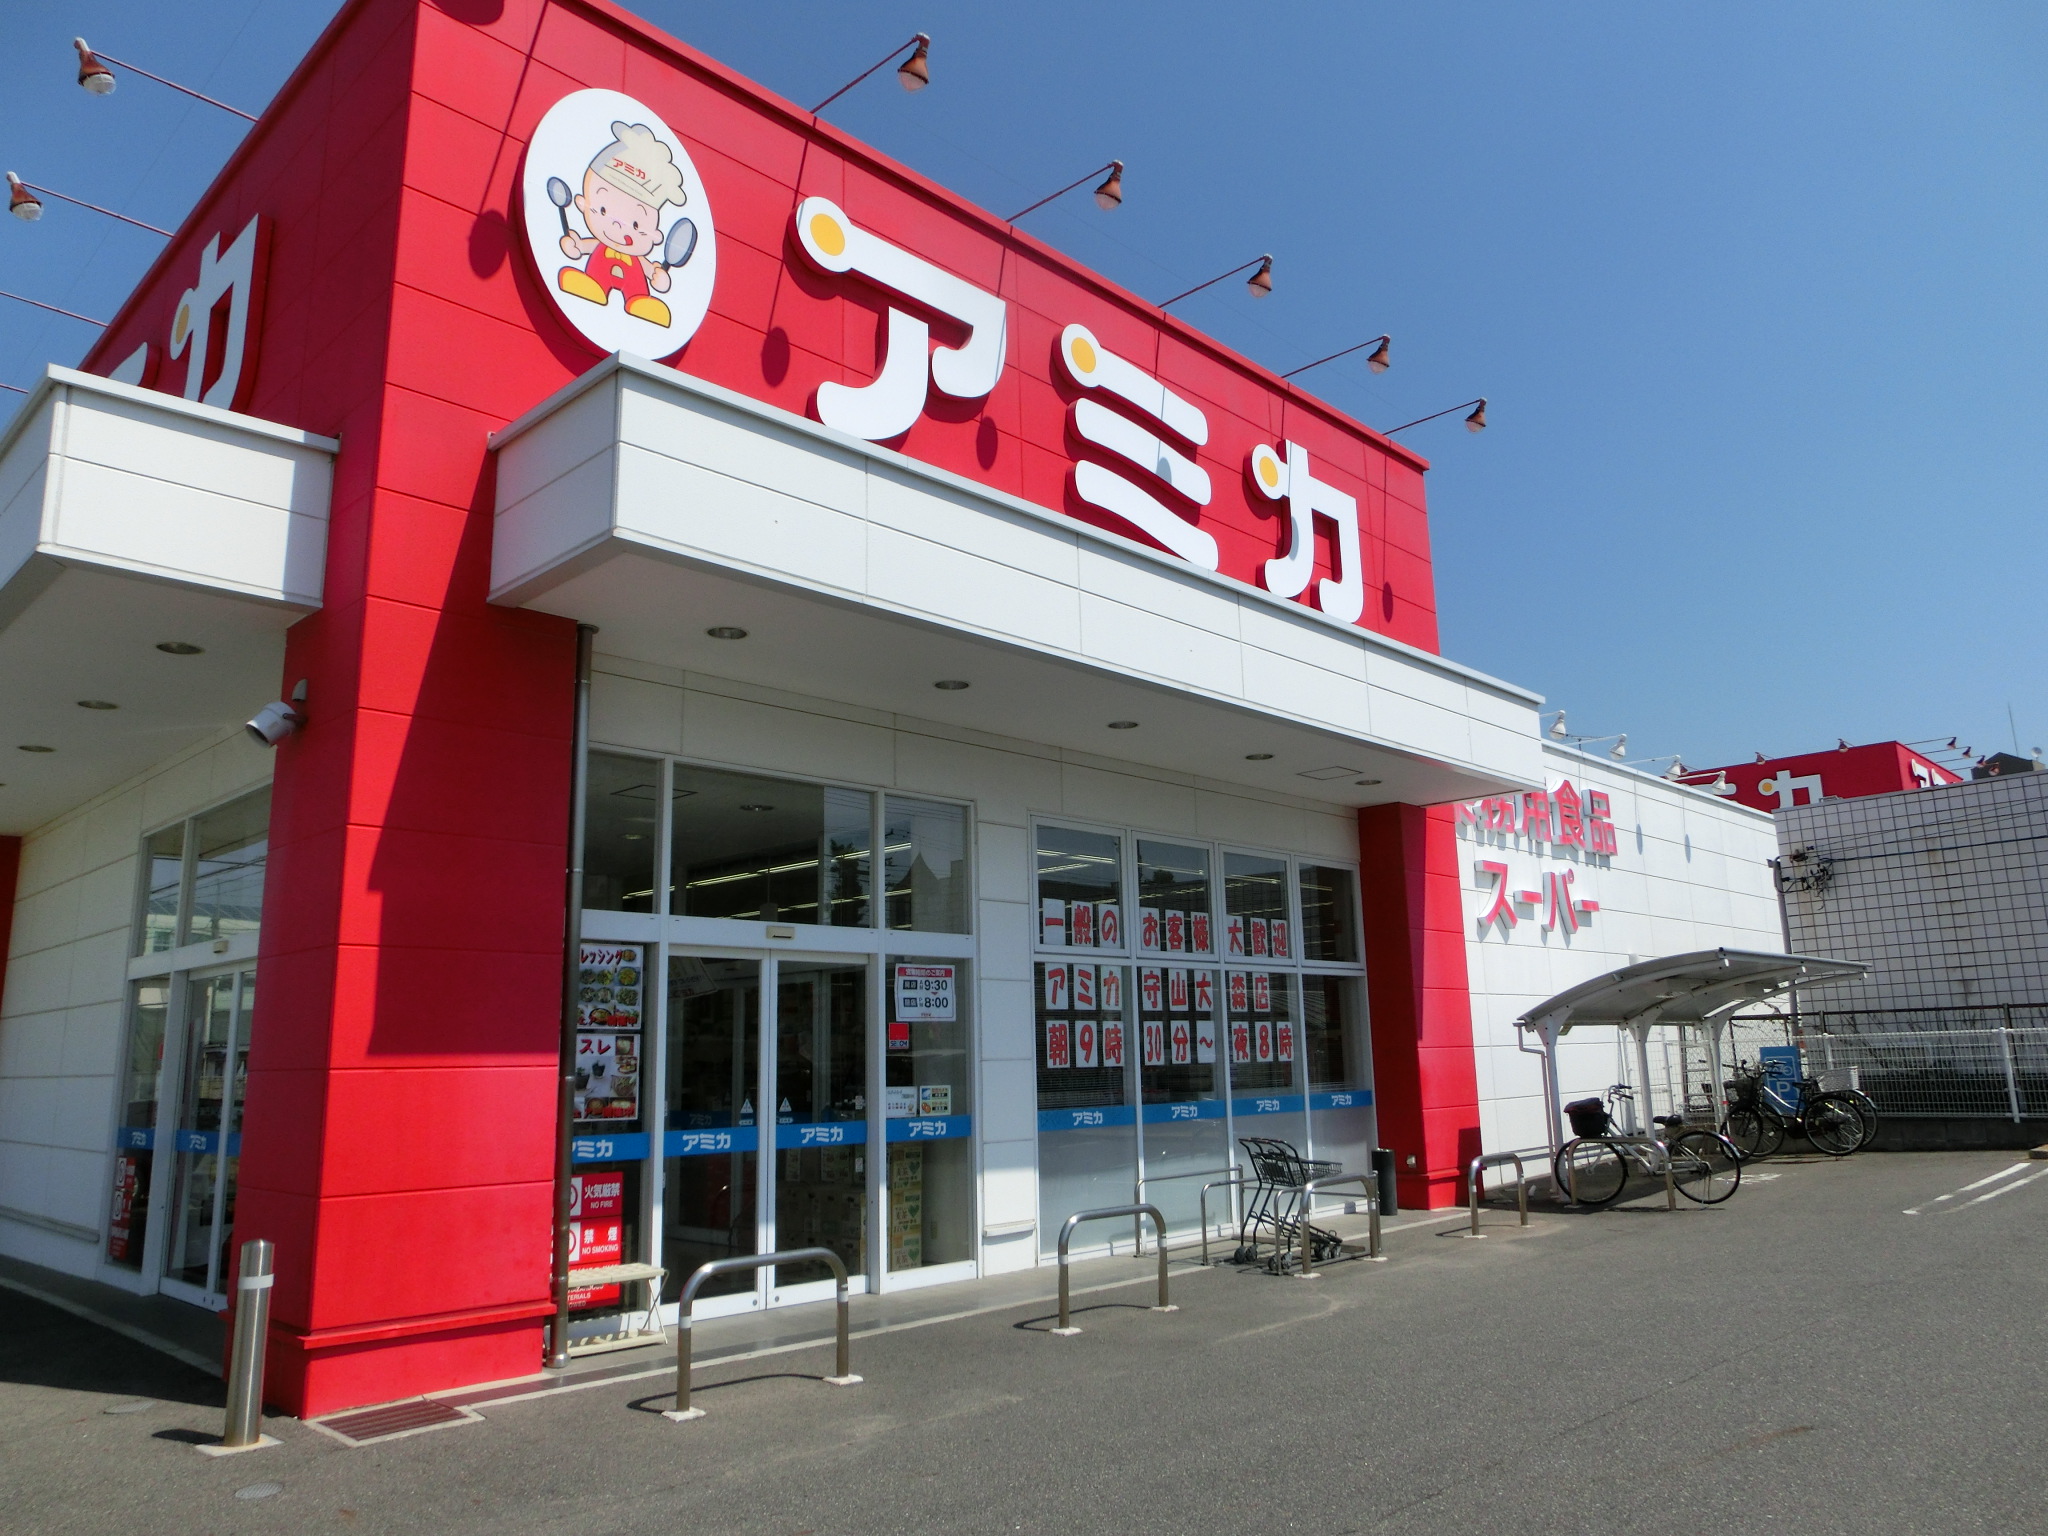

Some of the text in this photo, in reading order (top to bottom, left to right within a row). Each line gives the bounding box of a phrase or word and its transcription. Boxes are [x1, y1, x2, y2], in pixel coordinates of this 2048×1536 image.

[612, 157, 646, 180] アミカ
[107, 213, 259, 411] カ
[796, 196, 1364, 624] アミカ
[1474, 860, 1600, 935] スーパー
[924, 980, 948, 990] 9:30
[924, 997, 949, 1008] 8:00
[1256, 1099, 1280, 1112] アミカ
[1331, 1094, 1352, 1106] アミカ
[1072, 1110, 1103, 1126] アミカ
[1171, 1105, 1198, 1119] アミカ
[800, 1126, 843, 1144] アミカ
[908, 1121, 947, 1138] アミカ
[572, 1139, 613, 1158] ミカ
[682, 1133, 731, 1152] アミカ
[584, 1183, 620, 1199] 火気厳禁
[590, 1199, 613, 1209] NO FIRE
[581, 1243, 619, 1255] NO SMOKING
